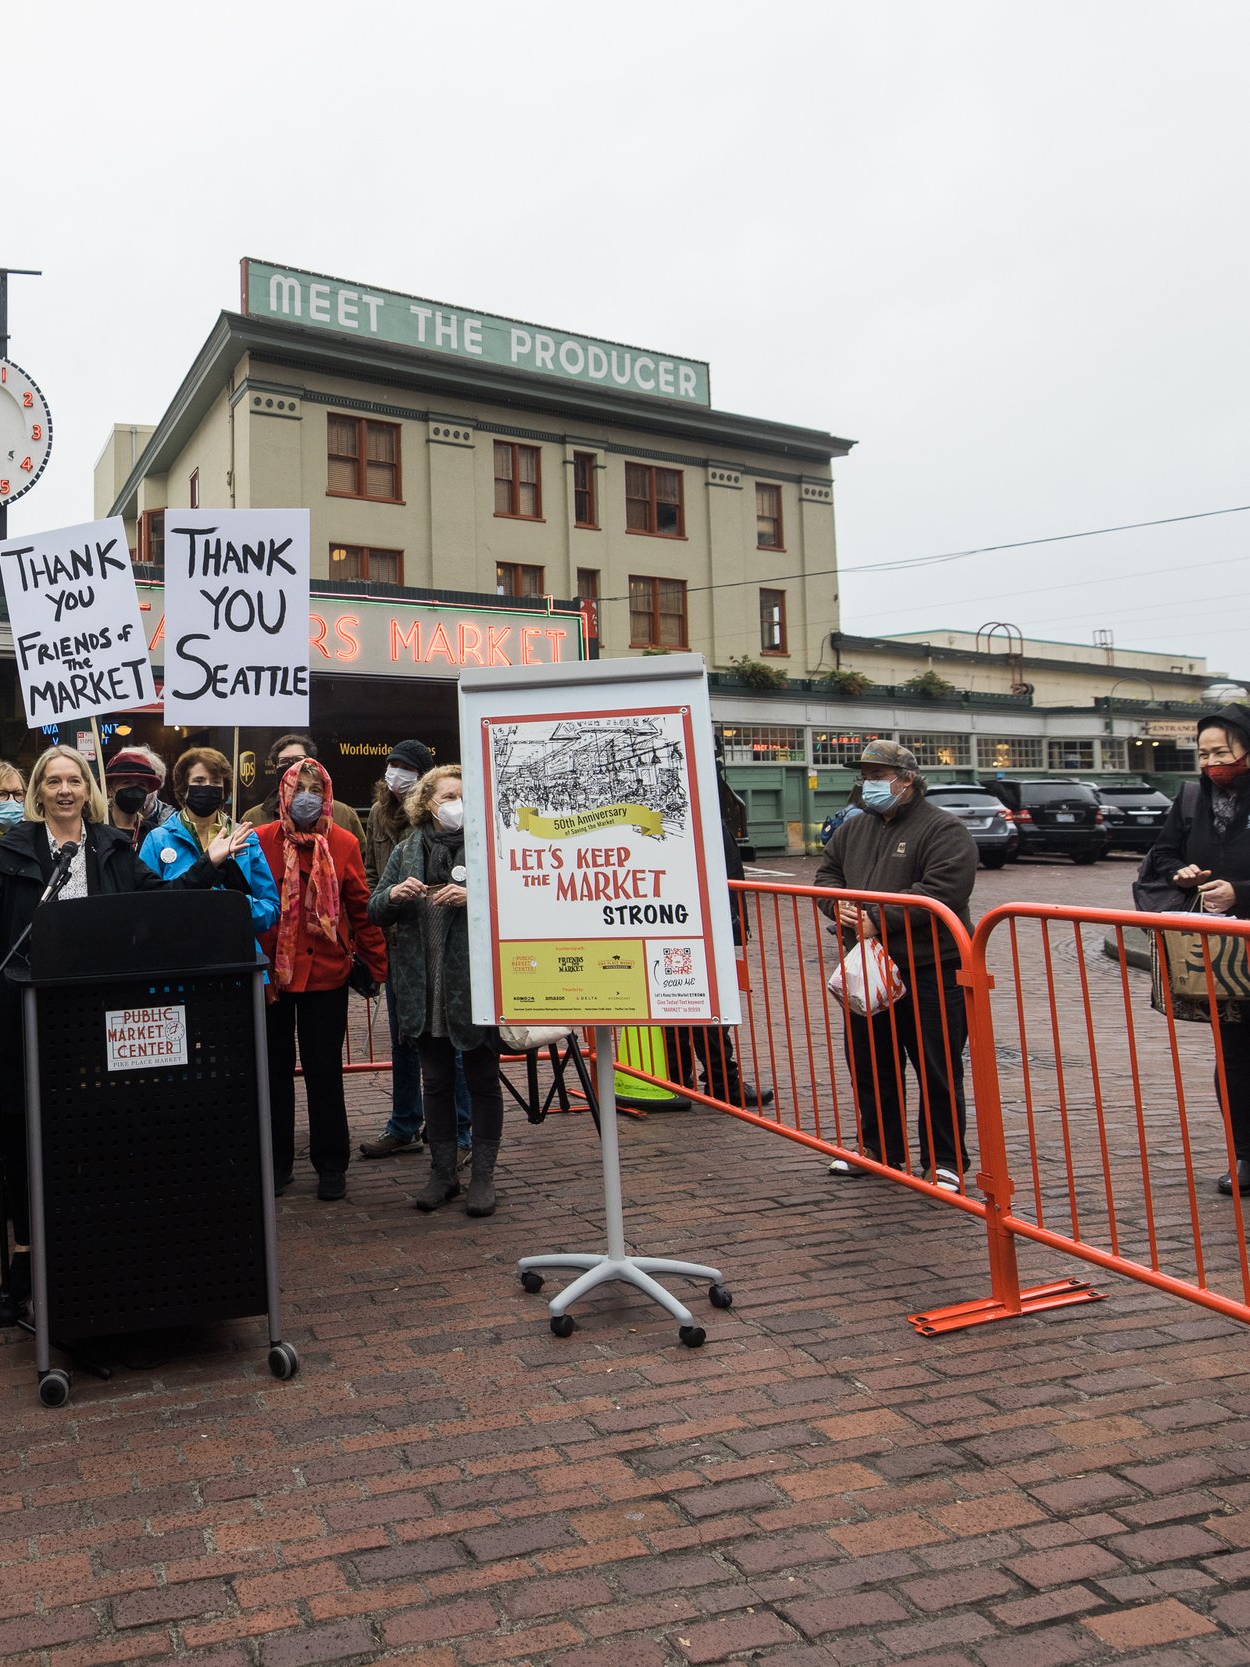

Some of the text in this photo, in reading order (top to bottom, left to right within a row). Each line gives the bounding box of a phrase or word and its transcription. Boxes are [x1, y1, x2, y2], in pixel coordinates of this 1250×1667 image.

[269, 273, 697, 398] MEET THE PRODUCER
[1, 367, 7, 383] 1
[23, 392, 34, 407] 2
[31, 424, 42, 440] 3
[20, 457, 33, 472] 4
[0, 480, 10, 495] 5
[170, 527, 297, 578] THANK
[0, 539, 126, 592] THANK
[45, 586, 95, 622] YOU
[200, 586, 287, 635] YOU
[17, 627, 112, 671] FRIENDS
[390, 619, 568, 667] MARKET
[62, 657, 93, 671] The
[171, 633, 308, 701] SEATTLE
[30, 658, 146, 716] MARKET
[340, 742, 393, 755] Worldwide
[240, 762, 254, 781] ups
[554, 807, 627, 830] 50th Anniversary
[571, 826, 587, 835] Saving
[597, 819, 615, 827] Market
[510, 844, 631, 871] LET'S KEEP
[522, 869, 667, 902] THE MARKET
[602, 904, 689, 925] STRONG
[558, 965, 584, 973] MARKET
[663, 977, 695, 988] SCAN ME
[123, 1007, 173, 1025] PUBLIC
[108, 1024, 164, 1042] MARKET
[117, 1041, 174, 1058] CENTER
[154, 1056, 182, 1064] MARKET
